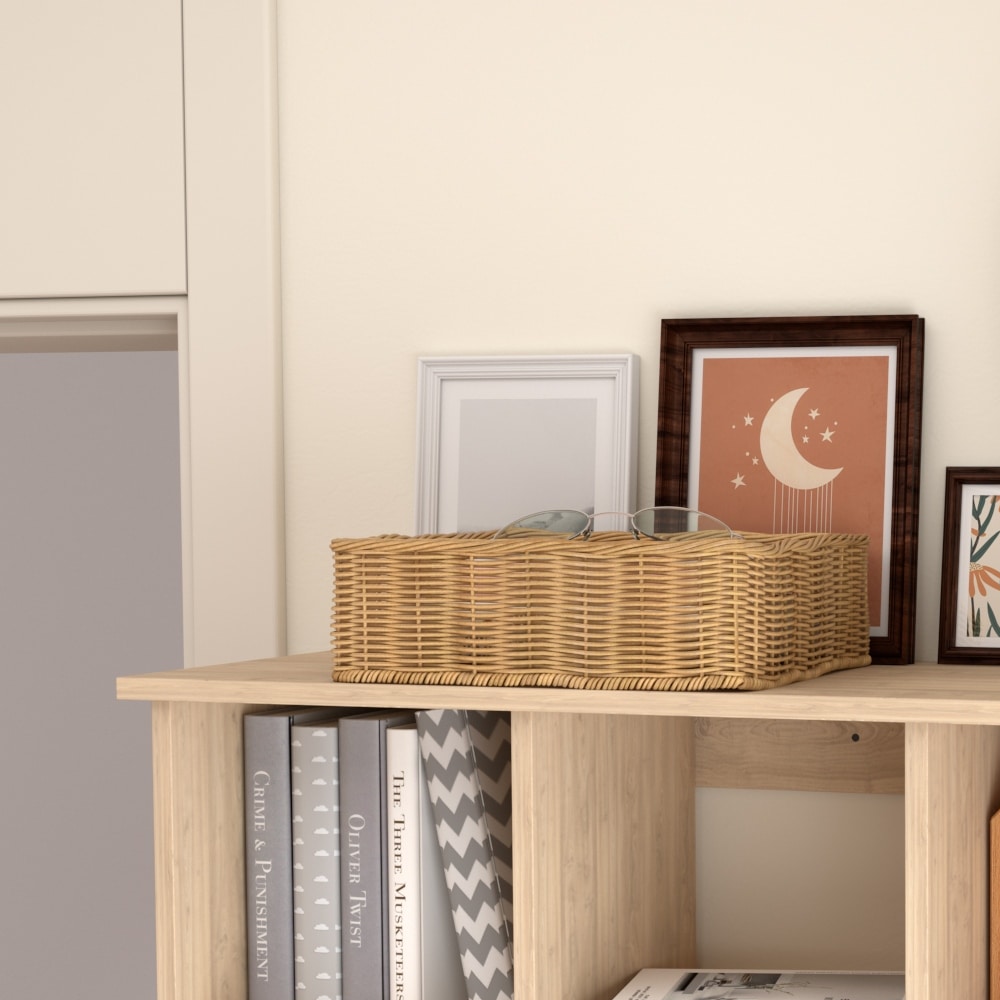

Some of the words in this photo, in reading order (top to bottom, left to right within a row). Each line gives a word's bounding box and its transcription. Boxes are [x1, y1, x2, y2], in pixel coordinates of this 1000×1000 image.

[253, 770, 271, 832] CRIME
[392, 771, 405, 808] THE
[254, 838, 267, 851] &
[348, 813, 366, 885] OLIVER
[393, 815, 406, 875] THREE
[255, 859, 272, 982] PUNISHMENT
[349, 891, 367, 948] TWIST
